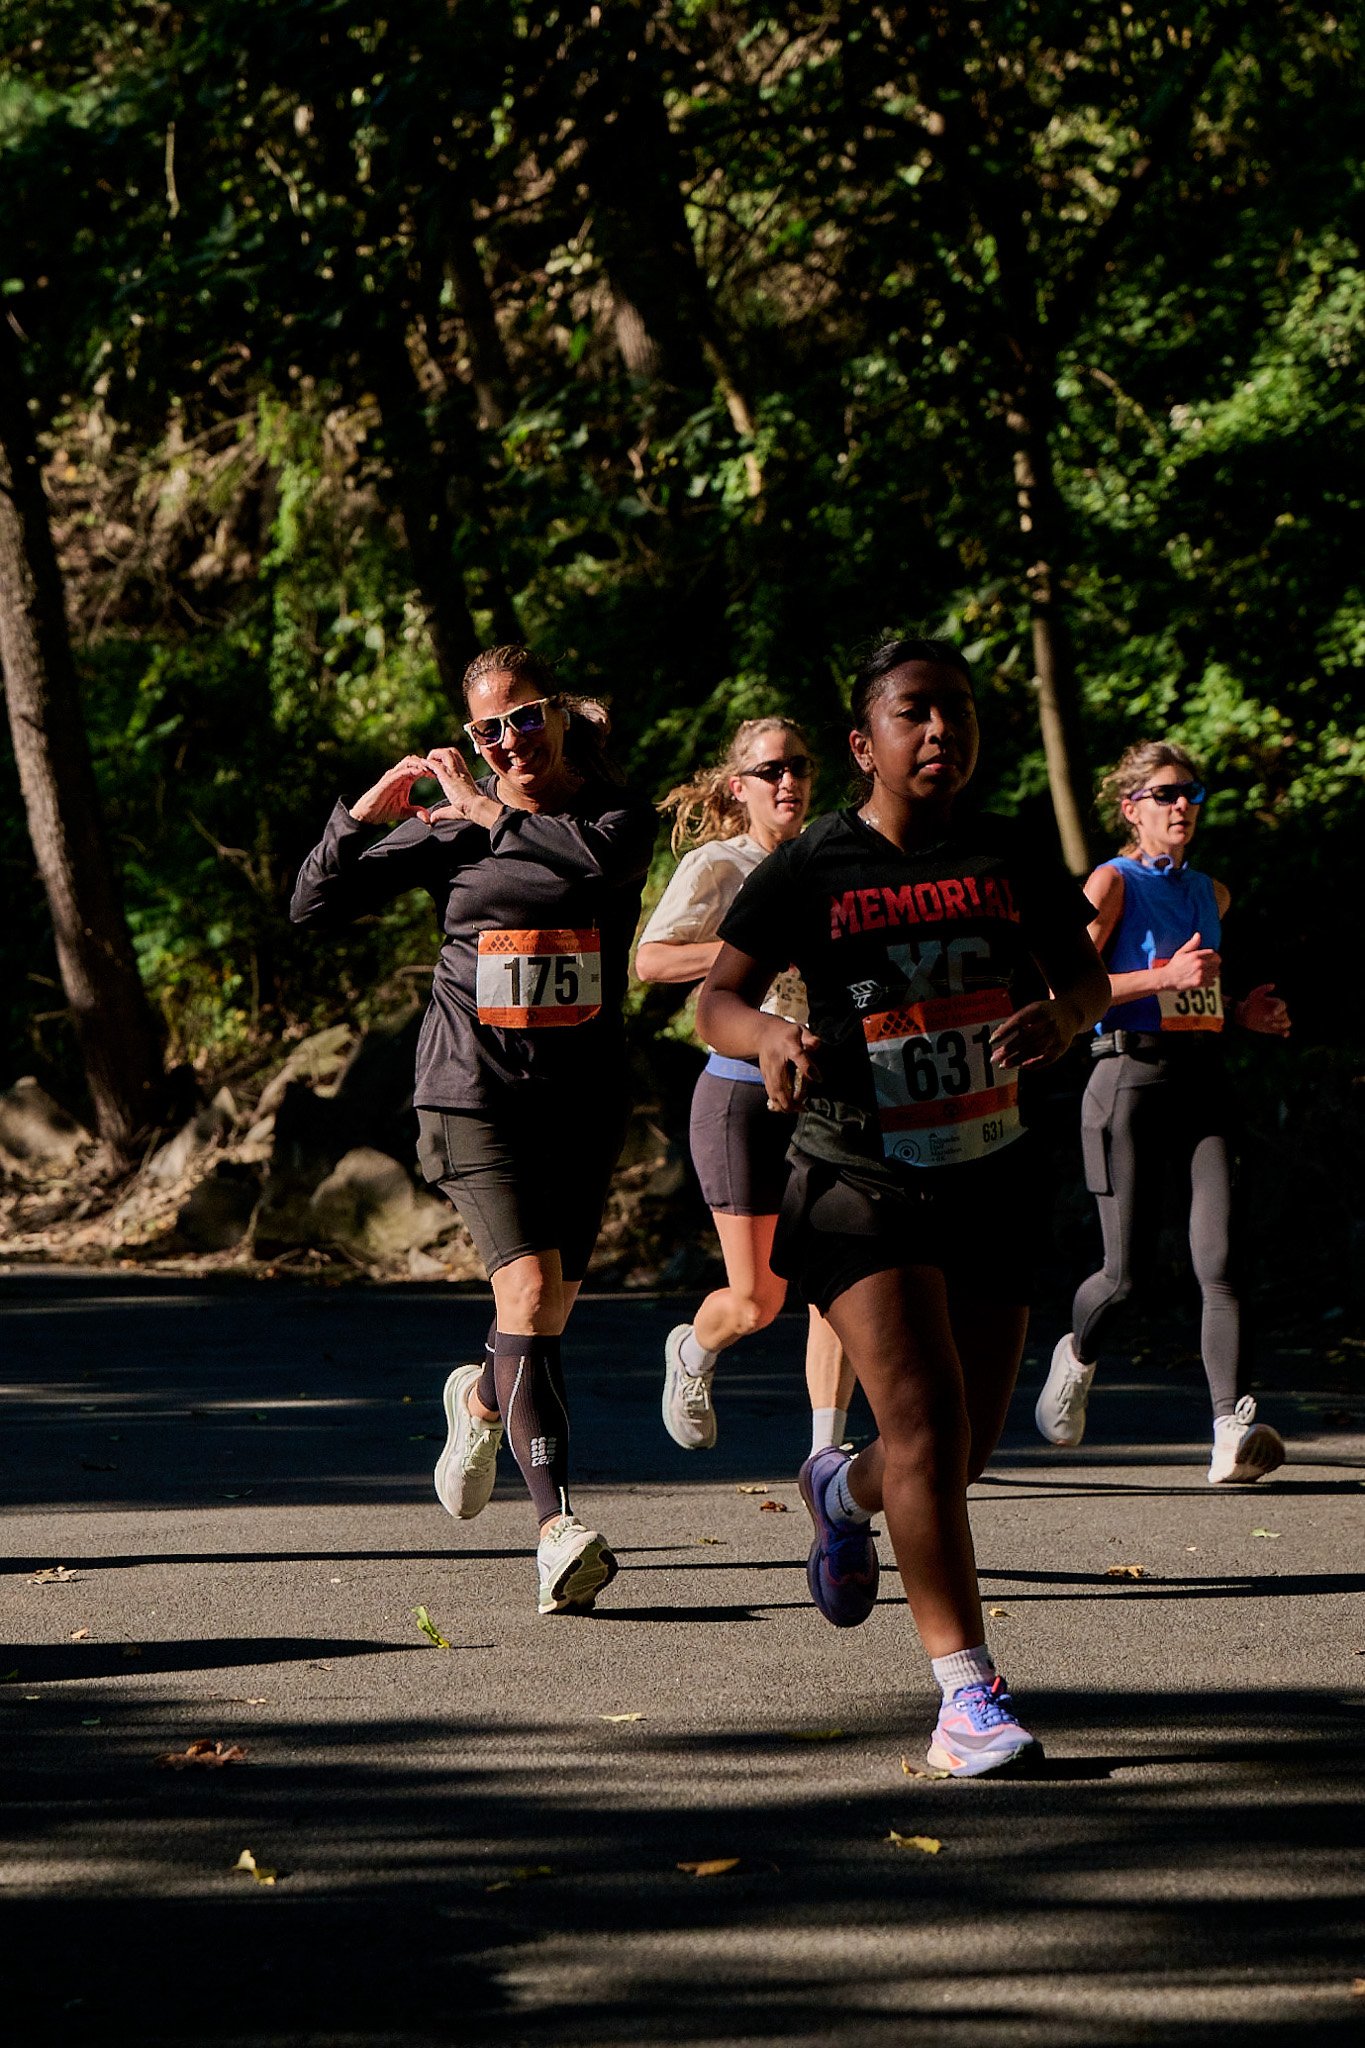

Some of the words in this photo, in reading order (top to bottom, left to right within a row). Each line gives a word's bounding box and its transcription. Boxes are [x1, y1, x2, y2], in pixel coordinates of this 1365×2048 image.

[830, 876, 1022, 941] MEMORIAL
[504, 956, 579, 1006] 175
[886, 935, 992, 1005] XC
[902, 1024, 995, 1102] 631
[983, 1119, 1004, 1143] 631
